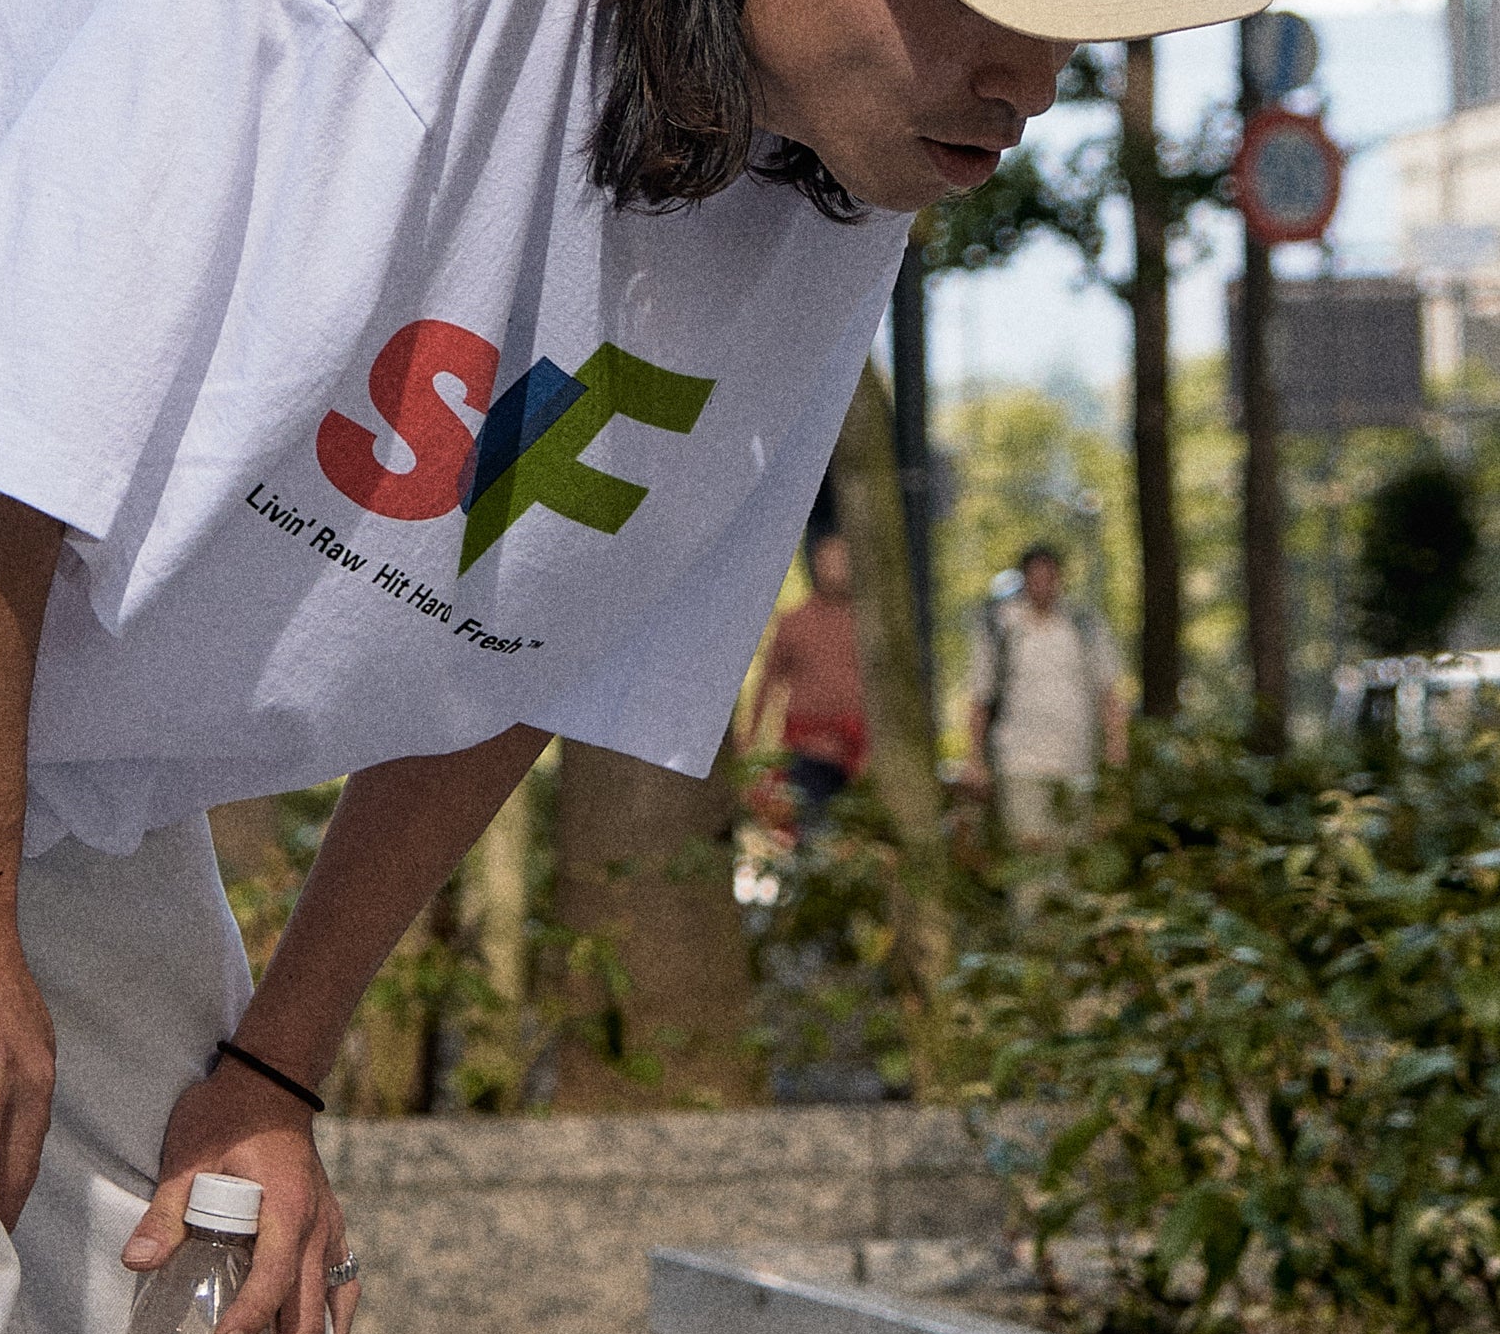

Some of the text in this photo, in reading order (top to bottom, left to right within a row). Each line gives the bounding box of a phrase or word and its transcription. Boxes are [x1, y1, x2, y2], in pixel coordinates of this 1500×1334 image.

[245, 482, 317, 537] Livin'
[308, 525, 368, 573] Raw
[371, 562, 411, 599] Hit
